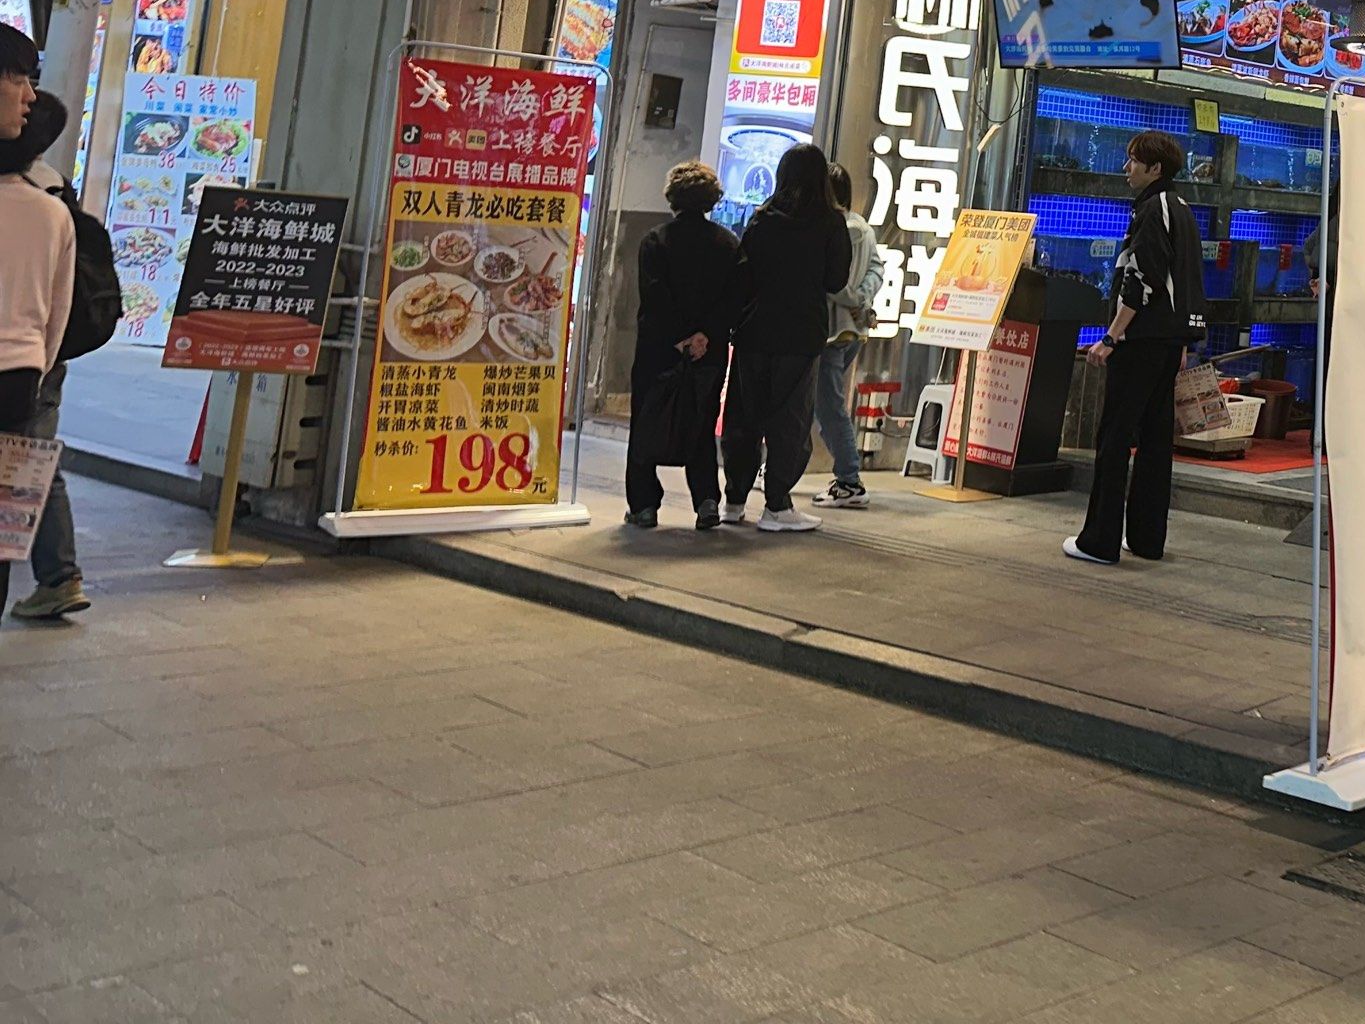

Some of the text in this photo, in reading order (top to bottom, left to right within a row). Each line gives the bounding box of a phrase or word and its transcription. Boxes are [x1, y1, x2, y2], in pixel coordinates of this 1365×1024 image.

[141, 76, 246, 105] 今日特价
[410, 68, 587, 127] 大洋海鲜
[727, 79, 818, 108] 多间豪华包厢
[491, 131, 583, 159] 上榜餐厅
[158, 150, 176, 169] 38
[220, 155, 236, 174] 25
[414, 156, 578, 187] 厦门电视台展播品牌
[252, 198, 317, 217] 大众点评
[401, 189, 566, 224] 双人青龙必吃套餐
[201, 213, 336, 244] 大洋海鲜城
[960, 213, 1032, 232] 荣登厦门美团
[211, 240, 317, 261] 海鲜批发加工
[214, 259, 306, 277] 2022-2023
[228, 277, 286, 292] 上榜餐厅
[189, 291, 316, 315] 全年五星好评
[381, 365, 458, 381] 清蒸小青龙
[379, 382, 441, 397] 椒盐海虾
[377, 398, 539, 415] 开胃凉菜 清炒时蔬
[376, 415, 509, 433] 酱油水黄花鱼 米饭
[419, 432, 533, 494] 198
[531, 476, 547, 494] 元
